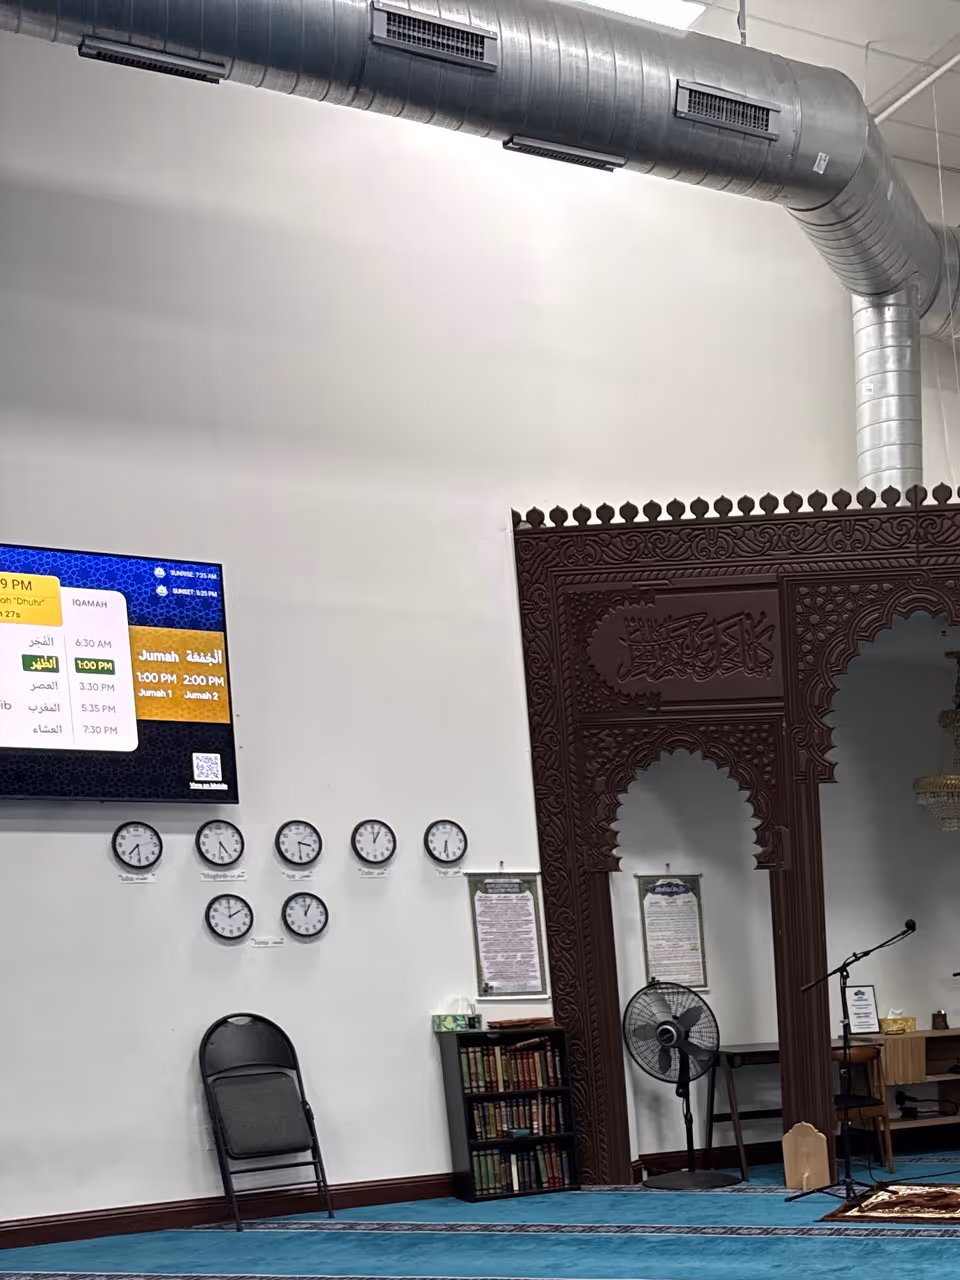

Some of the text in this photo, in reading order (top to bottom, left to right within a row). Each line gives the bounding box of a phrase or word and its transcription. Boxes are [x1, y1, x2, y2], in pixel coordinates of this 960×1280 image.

[12, 579, 32, 591] PM
[72, 599, 107, 608] IQAMAH
[75, 639, 112, 648] 6:30 AM
[138, 649, 179, 662] Jumah
[77, 660, 113, 670] 1:00 PM
[136, 672, 177, 684] 1:00 PM
[183, 674, 224, 687] 2:00 PM
[79, 681, 115, 692] 3:30 PM
[138, 688, 172, 698] Jumah 1
[184, 691, 219, 701] Jumah 2
[81, 704, 116, 713] 5:35 PM
[83, 725, 118, 734] 7:30 PM
